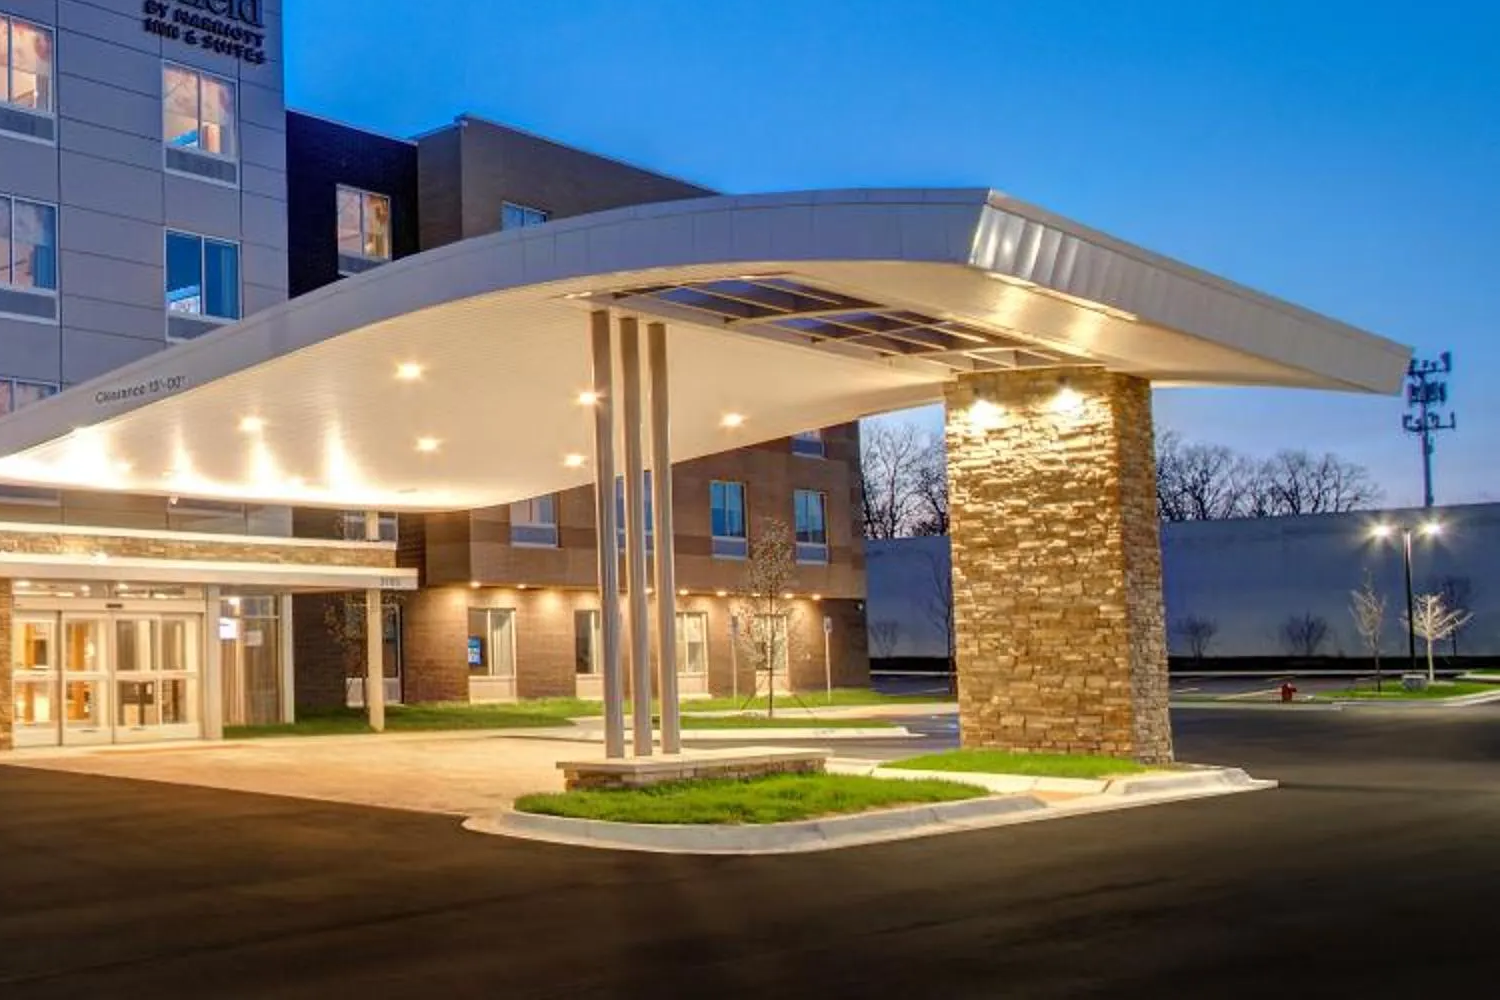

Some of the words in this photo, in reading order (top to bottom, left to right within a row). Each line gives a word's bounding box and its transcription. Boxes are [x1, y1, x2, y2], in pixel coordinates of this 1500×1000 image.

[143, 18, 179, 40] INN
[200, 34, 266, 65] SUITES
[173, 8, 265, 48] MARRIOTT
